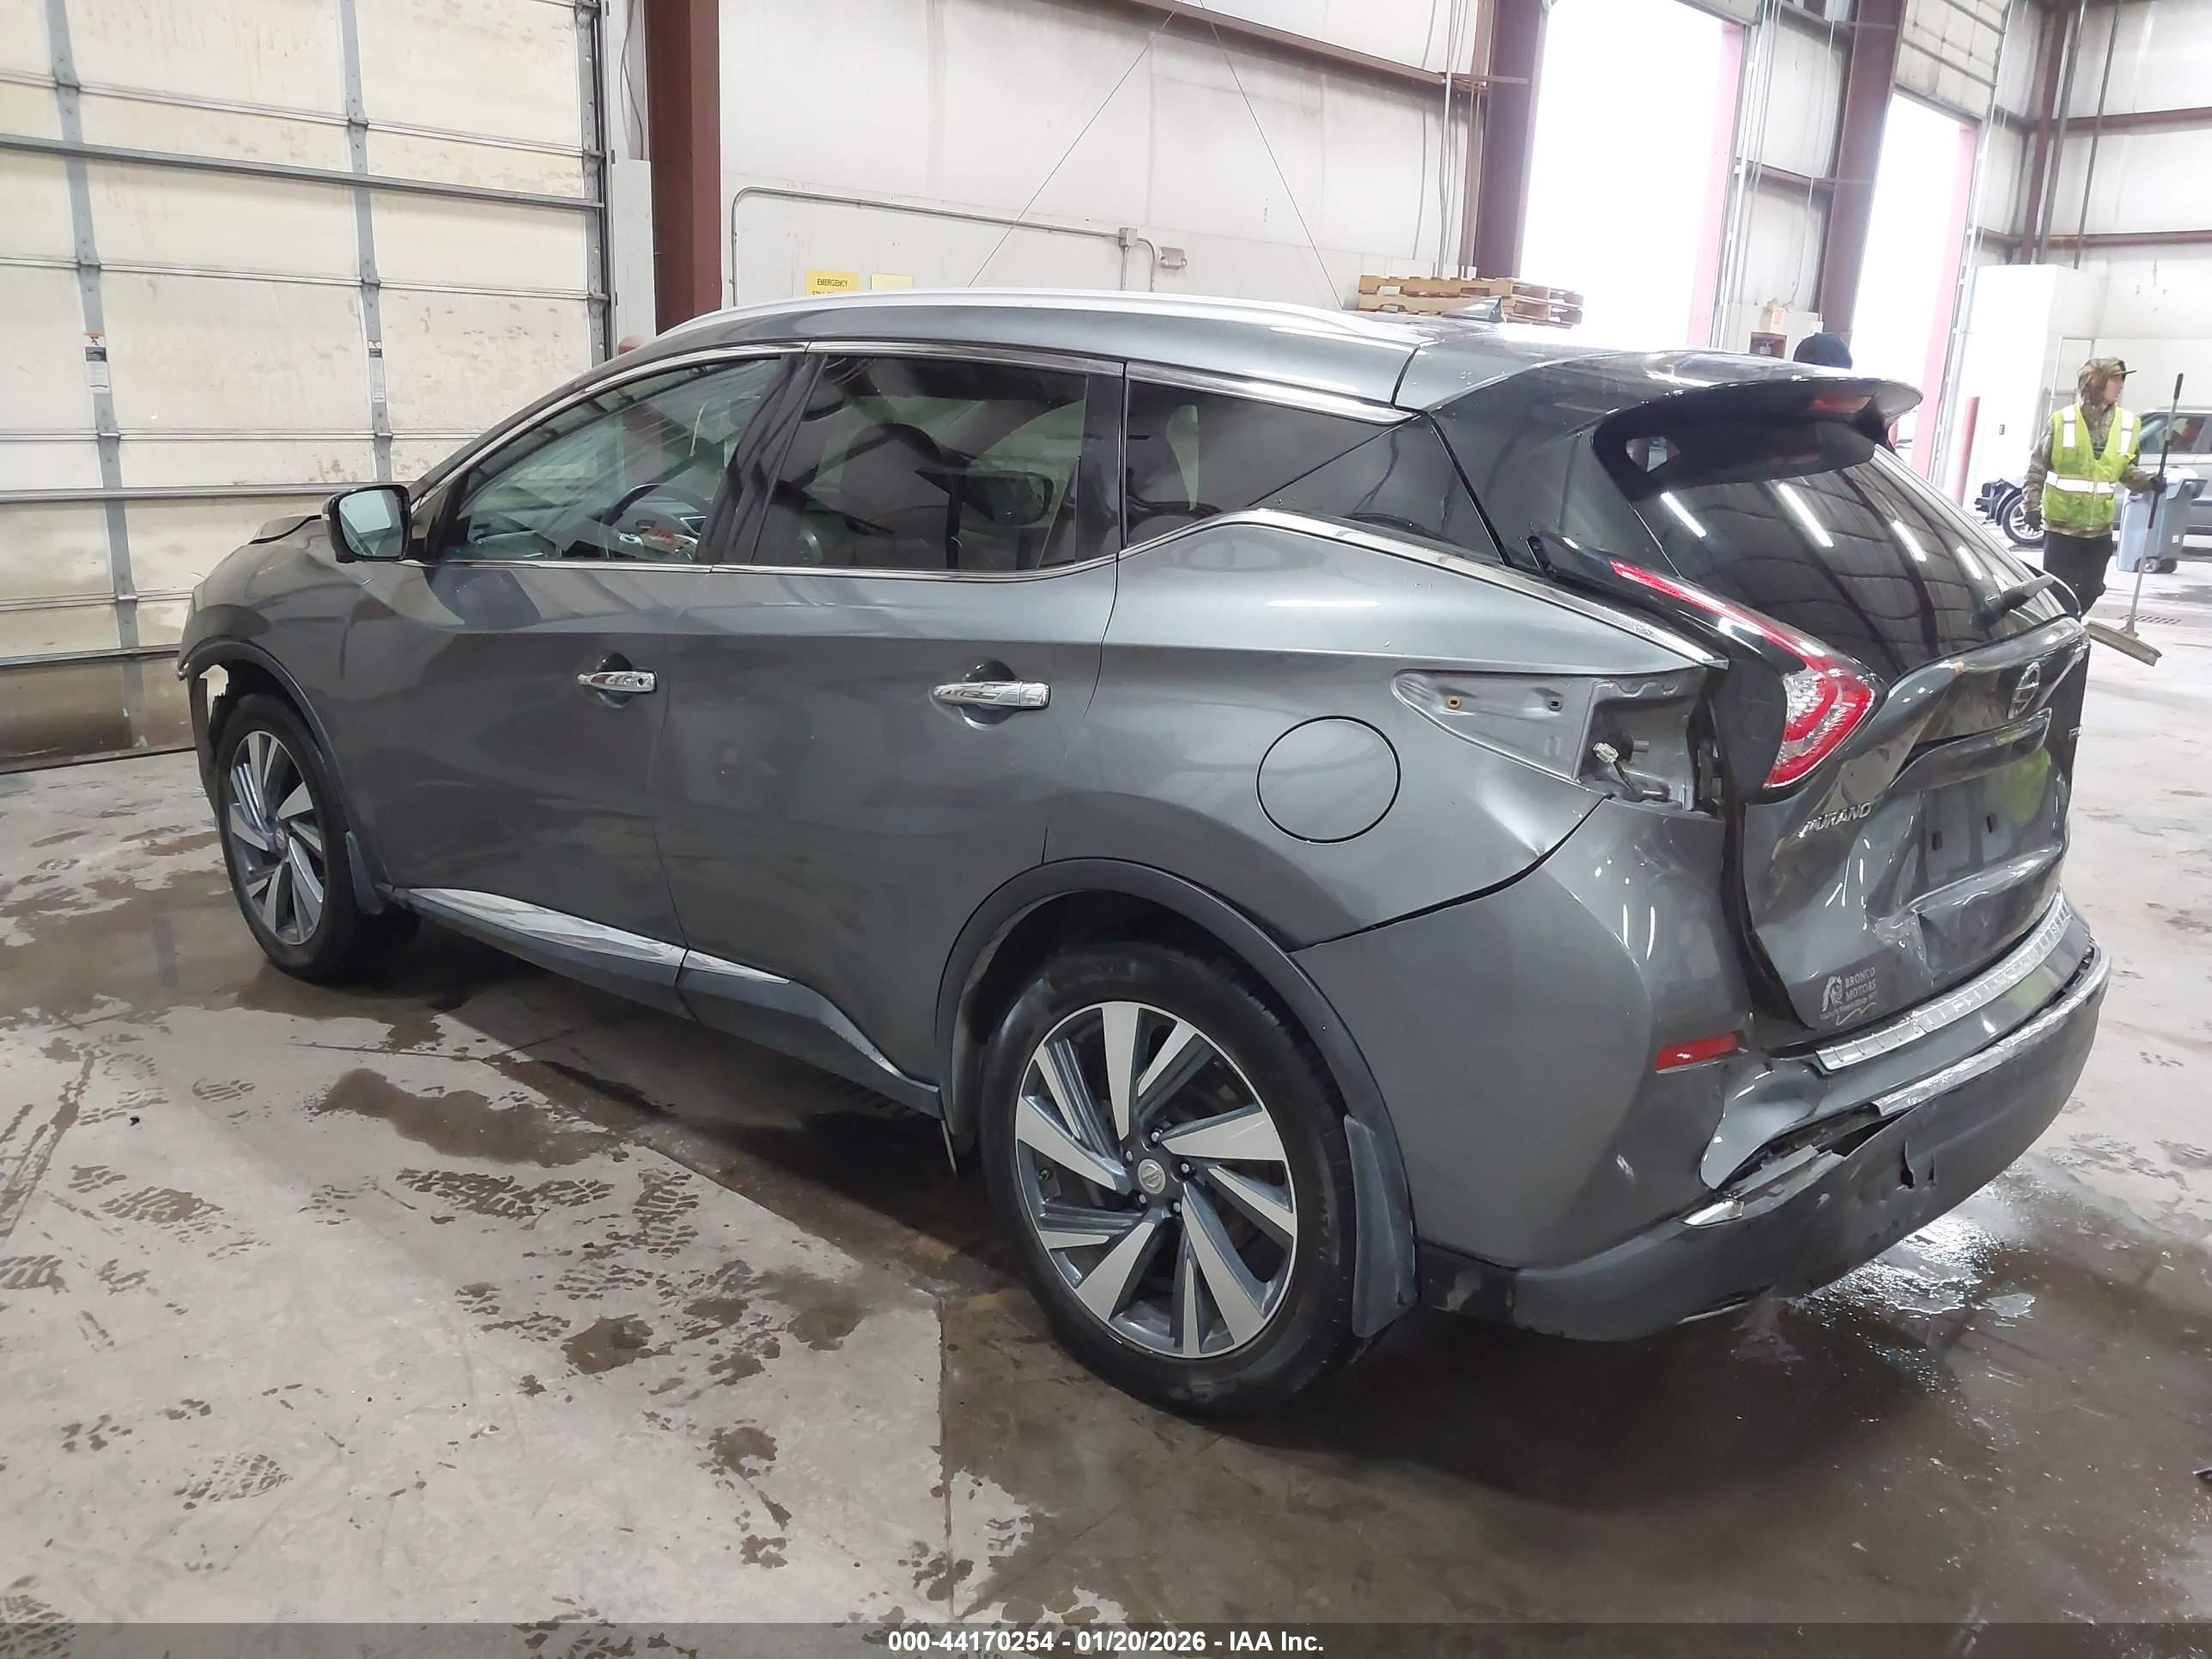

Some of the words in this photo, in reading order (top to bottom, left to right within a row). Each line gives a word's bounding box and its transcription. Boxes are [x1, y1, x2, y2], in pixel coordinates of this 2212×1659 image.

[817, 277, 848, 288] EMERGENCY
[1844, 967, 1875, 988] BRONCO
[1845, 978, 1876, 1001] MOTORS
